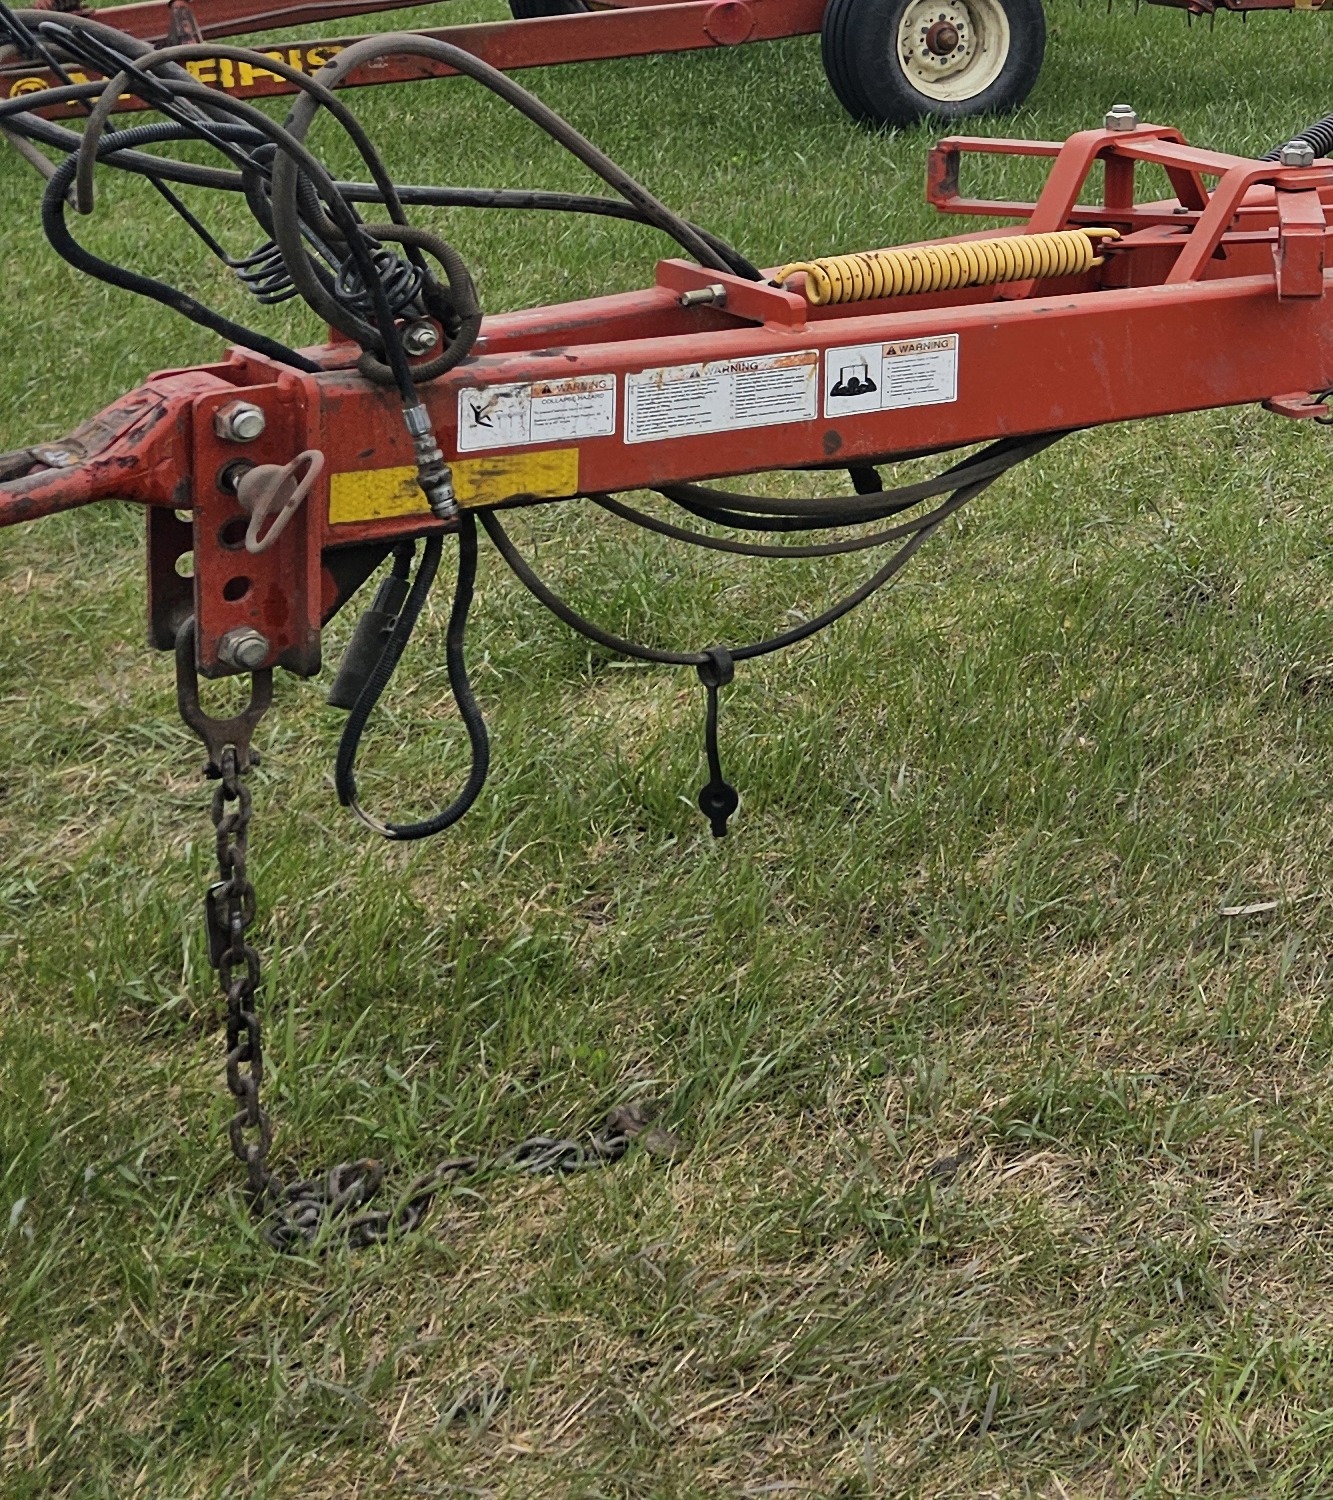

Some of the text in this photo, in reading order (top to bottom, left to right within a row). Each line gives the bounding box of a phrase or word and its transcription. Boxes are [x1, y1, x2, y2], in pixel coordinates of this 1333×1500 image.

[898, 339, 949, 354] WARNING
[704, 361, 759, 376] WARNING
[556, 379, 607, 396] WARNING
[542, 392, 605, 405] COLLAPSE HAZARD
